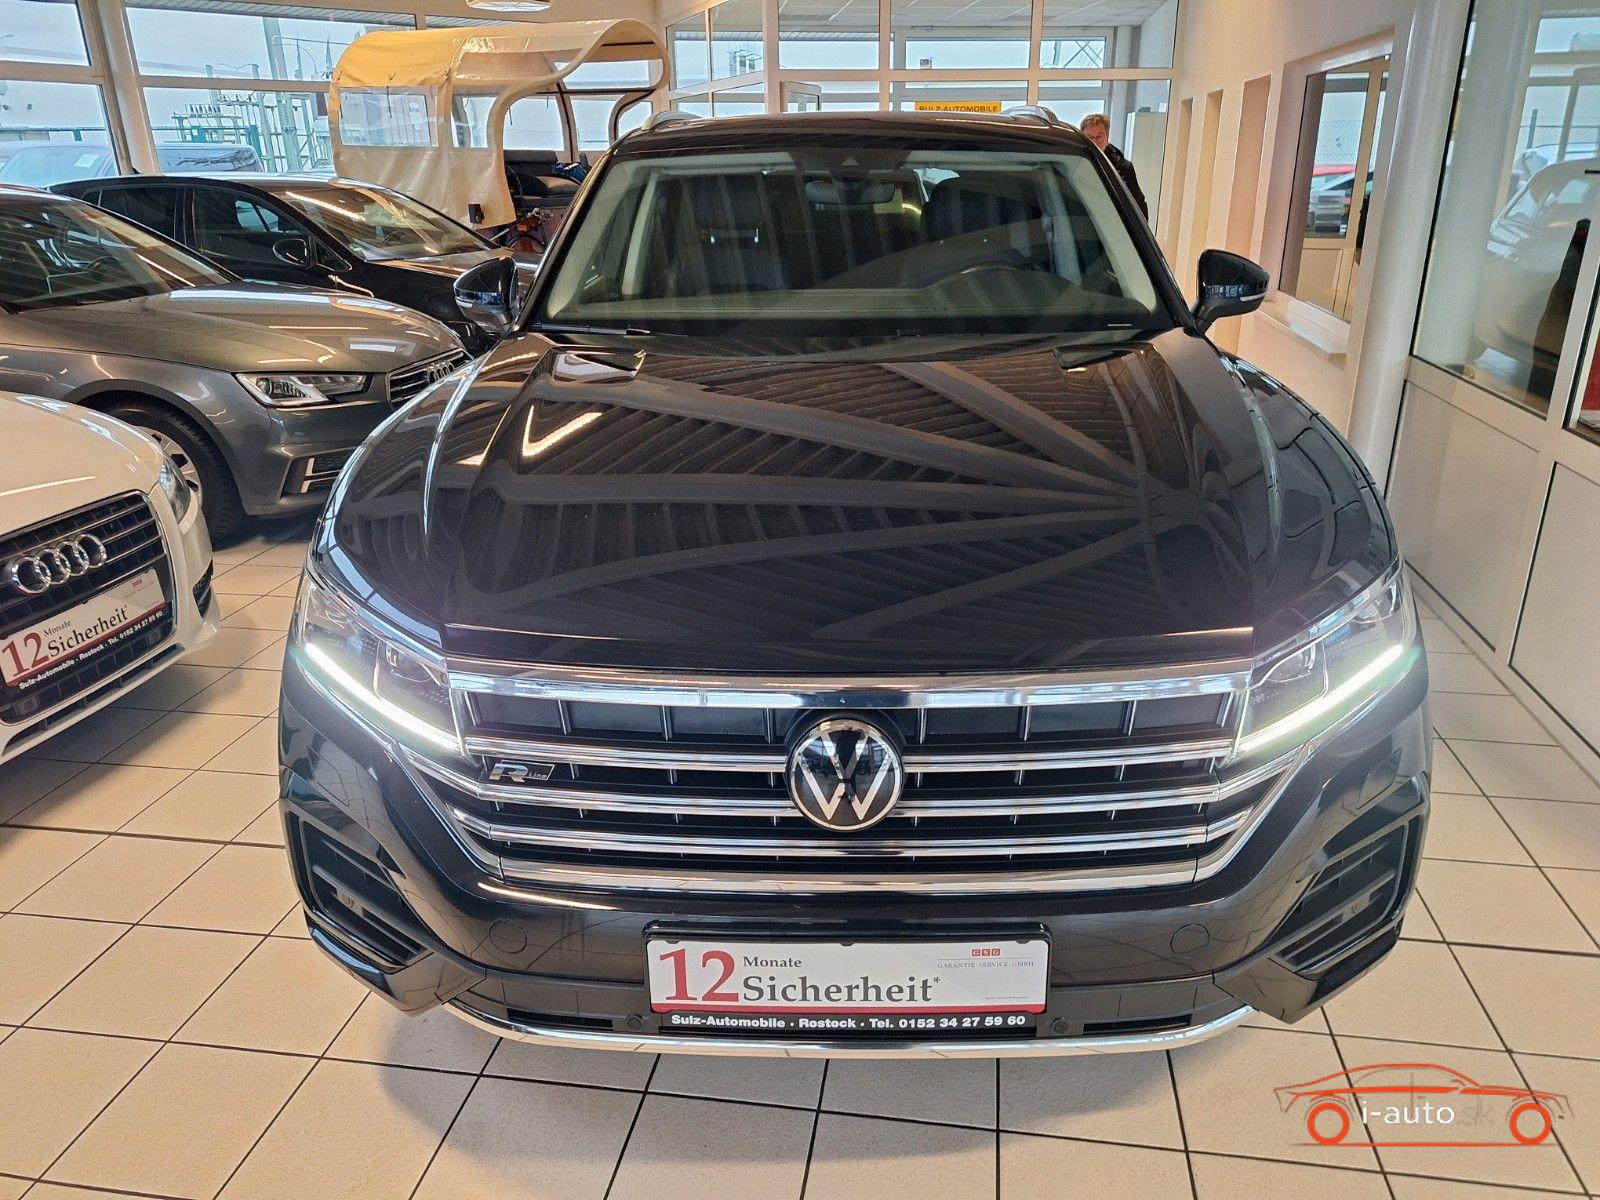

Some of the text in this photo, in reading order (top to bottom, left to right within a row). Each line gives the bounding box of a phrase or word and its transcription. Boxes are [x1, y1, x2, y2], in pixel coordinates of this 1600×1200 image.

[44, 620, 72, 637] Monate
[2, 632, 50, 677] 12
[19, 660, 75, 690] Sulz-Automobile
[489, 763, 529, 783] R
[742, 956, 802, 968] Monate
[972, 949, 1001, 957] GSG
[659, 948, 740, 1002] 12
[671, 1014, 1026, 1028] Sulz-Automobile Rostock Tel. 0152 34 27 59 60
